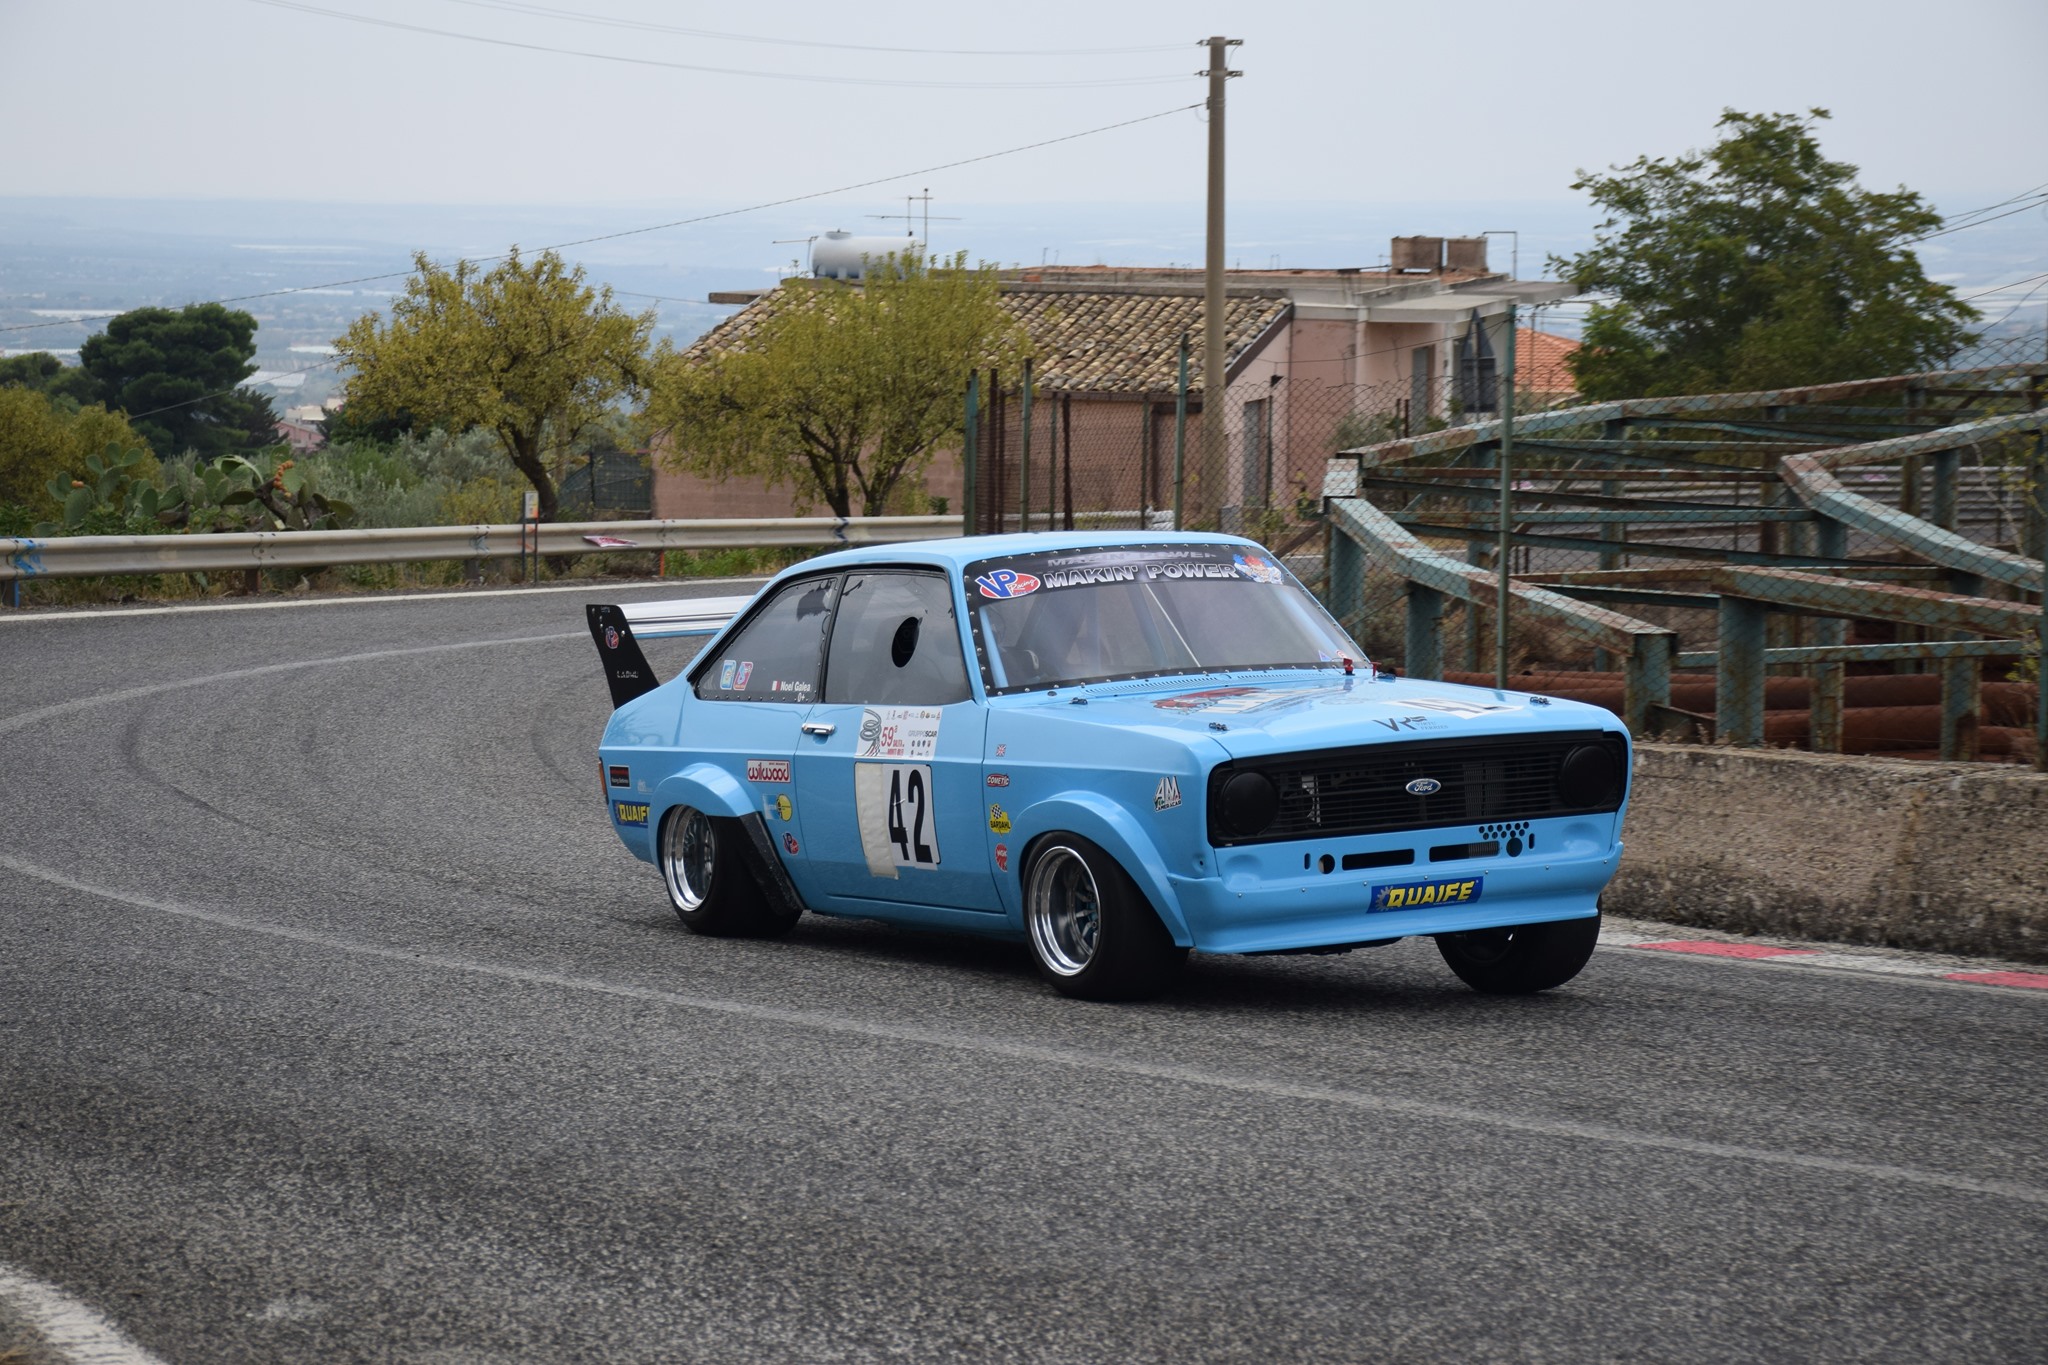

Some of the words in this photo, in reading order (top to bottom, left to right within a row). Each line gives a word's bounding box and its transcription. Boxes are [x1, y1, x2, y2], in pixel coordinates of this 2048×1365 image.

[975, 569, 1018, 599] VP
[1009, 578, 1036, 593] Racing
[1043, 565, 1138, 589] MAKIN'
[1145, 563, 1240, 580] POWER
[780, 681, 793, 691] Noel
[794, 681, 811, 692] Galea
[748, 762, 790, 781] wilwood
[987, 776, 1009, 785] COMETIC
[1413, 780, 1434, 792] Ford
[888, 769, 934, 864] 42
[990, 820, 1011, 830] BARDAHL
[1386, 880, 1476, 908] QUAIFE
